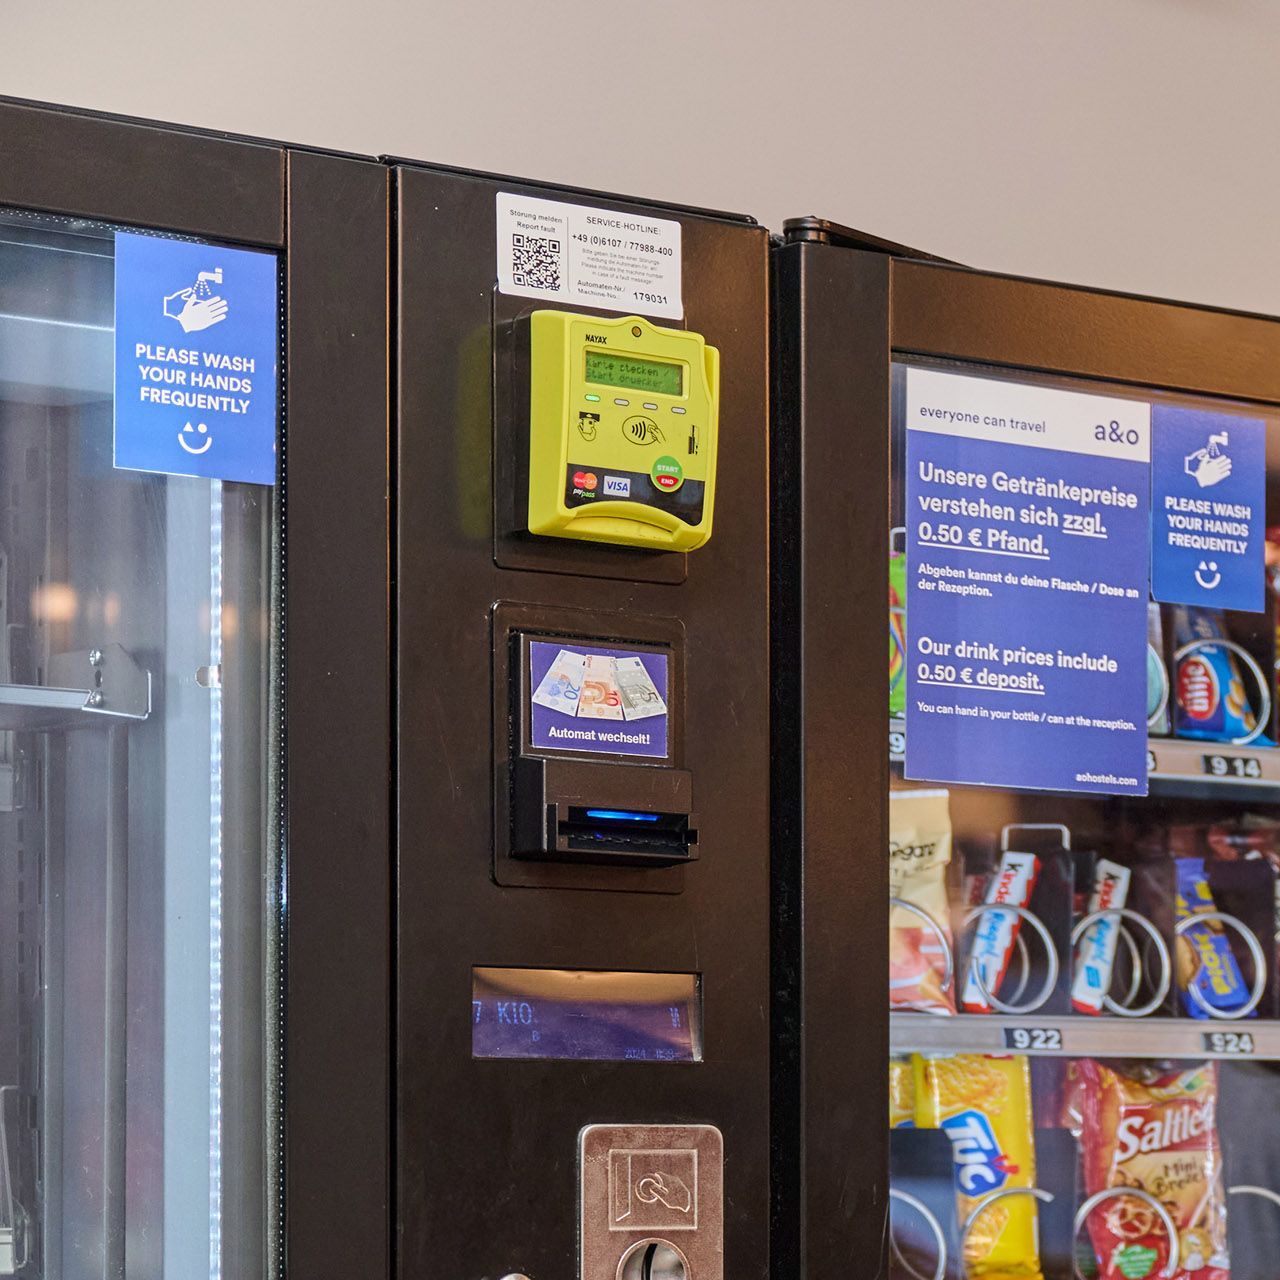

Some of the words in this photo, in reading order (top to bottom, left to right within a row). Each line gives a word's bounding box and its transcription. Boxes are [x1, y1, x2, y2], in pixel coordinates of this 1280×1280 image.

[572, 233, 588, 243] +49
[590, 235, 622, 248] (0)6107
[629, 241, 673, 257] 77988-400
[633, 292, 668, 305] 179031
[585, 334, 607, 345] NAYAX
[135, 343, 199, 365] PLEASE
[203, 352, 255, 373] WASH
[138, 365, 186, 386] YOUR
[191, 372, 251, 394] HANDS
[140, 387, 250, 414] FREQUENTLY
[919, 406, 980, 425] everyone
[983, 417, 1007, 427] can
[1010, 418, 1046, 433] travel
[1094, 421, 1140, 445] a&o
[657, 464, 680, 473] START
[607, 481, 629, 492] VISA
[661, 477, 674, 486] END
[918, 461, 987, 489] Unsere
[992, 471, 1138, 508] Getränkepreise
[918, 496, 1015, 522] verstehen
[1019, 504, 1059, 527] sich
[1063, 512, 1107, 534] zzgl.
[1165, 496, 1210, 515] PLEASE
[1212, 501, 1251, 520] WASH
[1167, 515, 1205, 532] YOUR
[1206, 518, 1249, 537] HANDS
[918, 521, 963, 544] 0.50
[968, 528, 982, 548] €
[987, 531, 1049, 556] Pfand.
[1168, 532, 1248, 555] FREQUENTLY
[918, 563, 965, 581] Abgeben
[968, 568, 1002, 583] kannst
[1005, 573, 1018, 585] du
[1021, 574, 1049, 588] deine
[1051, 577, 1089, 594] Flasche
[1099, 582, 1124, 597] Dose
[1126, 588, 1139, 598] an
[918, 579, 936, 591] der
[938, 580, 993, 599] Rezeption.
[918, 636, 950, 657] Our
[955, 641, 999, 662] drink
[1003, 646, 1054, 668] prices
[1057, 650, 1118, 674] include
[918, 663, 956, 683] 0.50
[960, 667, 973, 684] €
[976, 668, 1045, 692] deposit.
[917, 702, 934, 714] You
[936, 706, 953, 715] can
[955, 704, 979, 717] hand
[980, 706, 989, 717] in
[990, 709, 1011, 721] your
[1012, 709, 1040, 723] bottle
[1047, 714, 1064, 724] can
[1065, 714, 1075, 725] at
[1076, 715, 1092, 727] the
[1093, 717, 1137, 731] reception.
[548, 726, 596, 741] Automat
[598, 732, 650, 745] wechselt!
[1076, 772, 1138, 787] aohostels.com
[1013, 1029, 1062, 1048] 922
